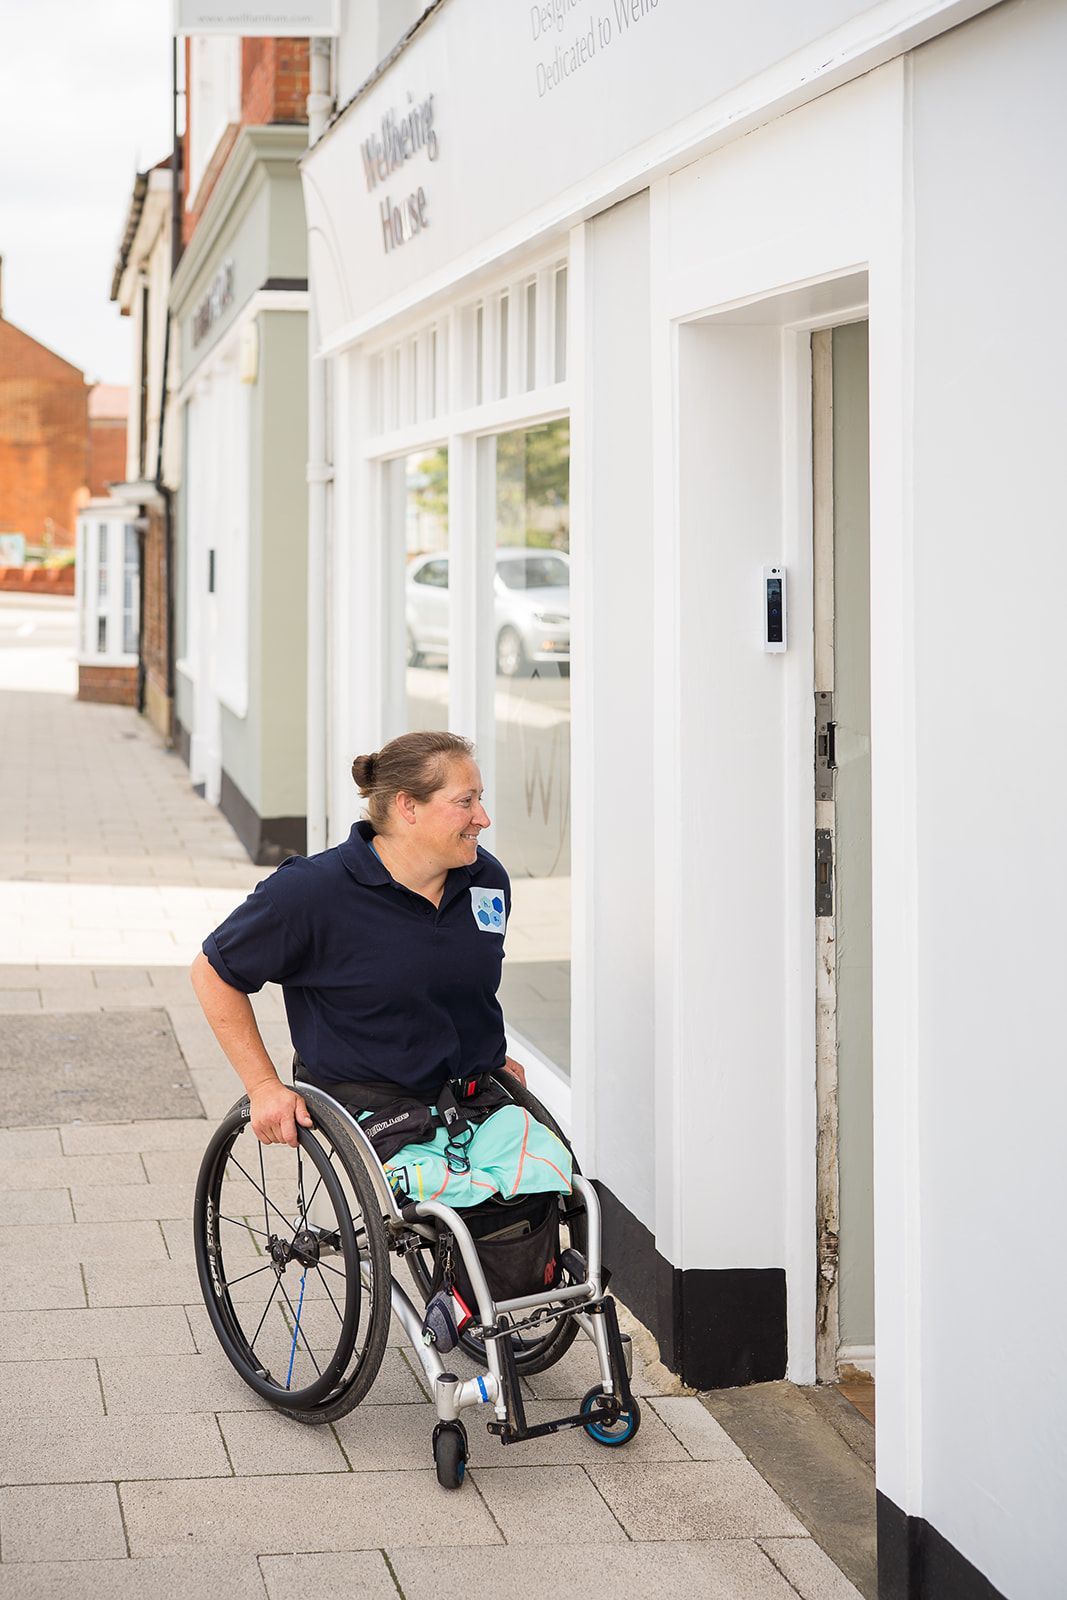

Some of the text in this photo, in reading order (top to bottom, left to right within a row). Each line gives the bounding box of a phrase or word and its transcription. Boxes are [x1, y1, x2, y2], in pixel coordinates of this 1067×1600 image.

[530, 0, 578, 41] Design
[536, 15, 596, 98] Dedicated
[598, 17, 611, 49] to
[360, 90, 439, 193] Wellbeing
[379, 186, 429, 254] House
